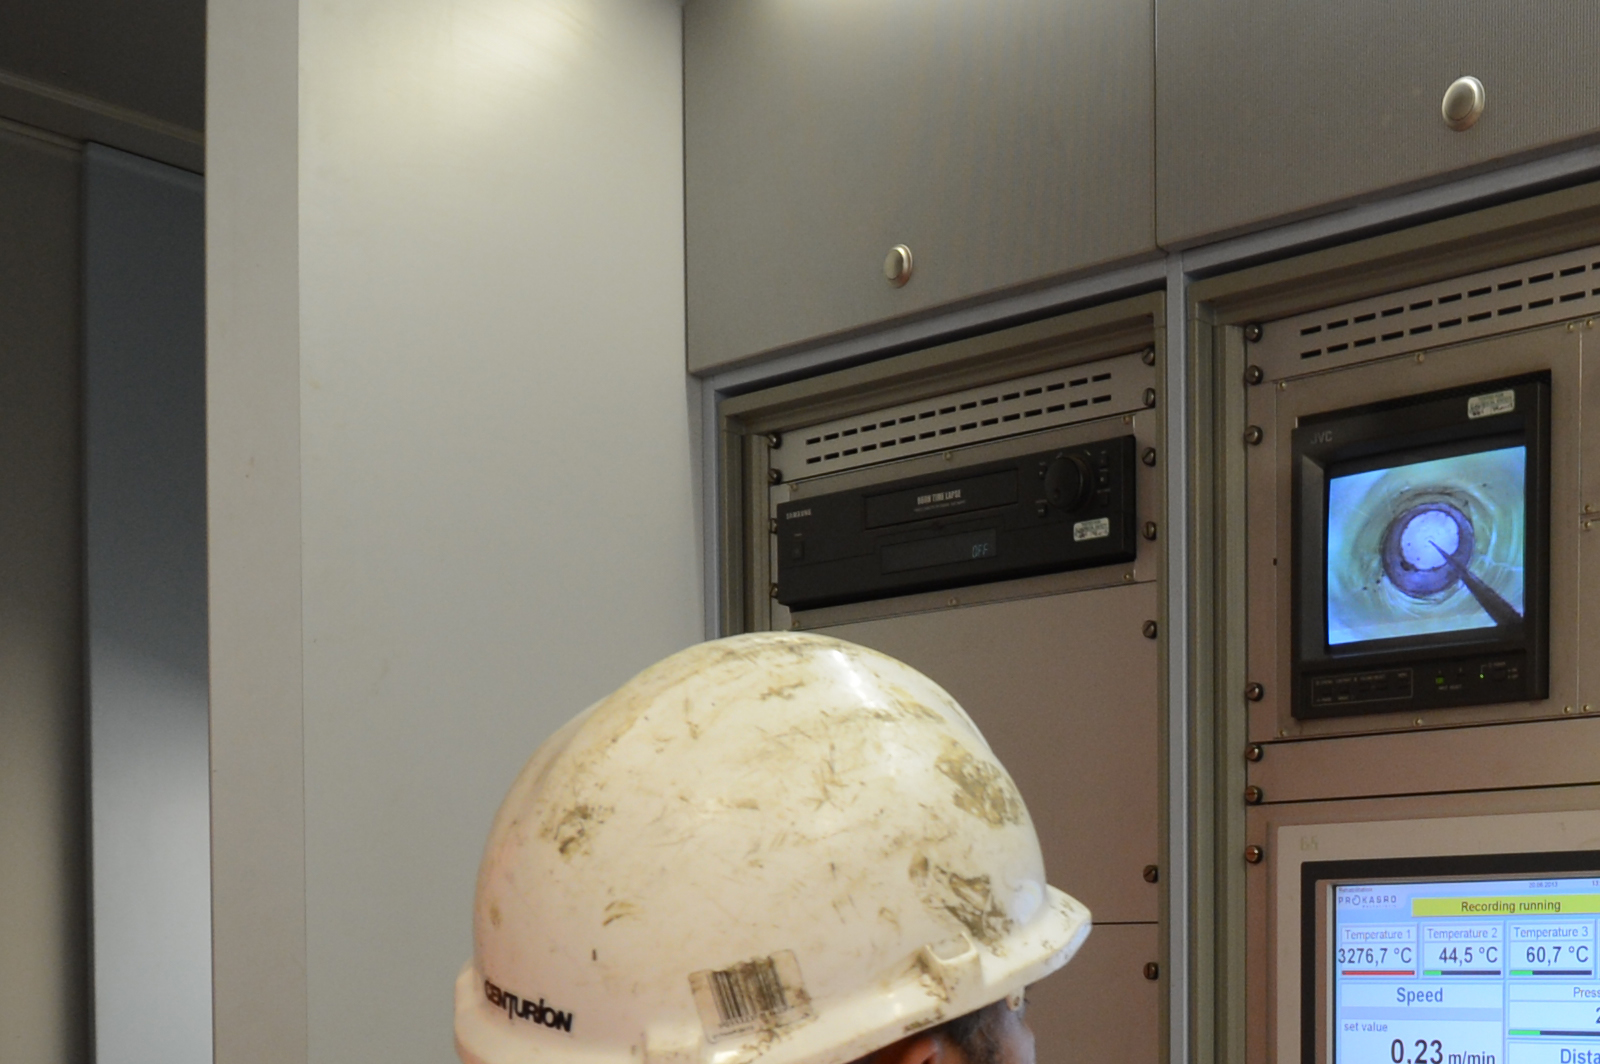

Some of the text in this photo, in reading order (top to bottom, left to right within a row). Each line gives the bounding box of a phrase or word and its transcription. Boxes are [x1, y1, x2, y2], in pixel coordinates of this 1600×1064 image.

[1310, 430, 1333, 444] JVC
[972, 543, 988, 558] OFF
[1338, 894, 1397, 906] PROKASRO
[1461, 899, 1561, 913] Recording running
[1345, 928, 1411, 941] Temperature 1
[1427, 927, 1498, 940] Temperature 2
[1513, 926, 1588, 939] Temperature 3
[1338, 946, 1412, 966] 3276,7 °C
[1438, 946, 1498, 965] 44,5 °C
[1526, 945, 1589, 966] 60,7 °C
[1396, 987, 1444, 1006] Speed
[484, 979, 573, 1033] CENTURION
[1344, 1022, 1388, 1033] set value
